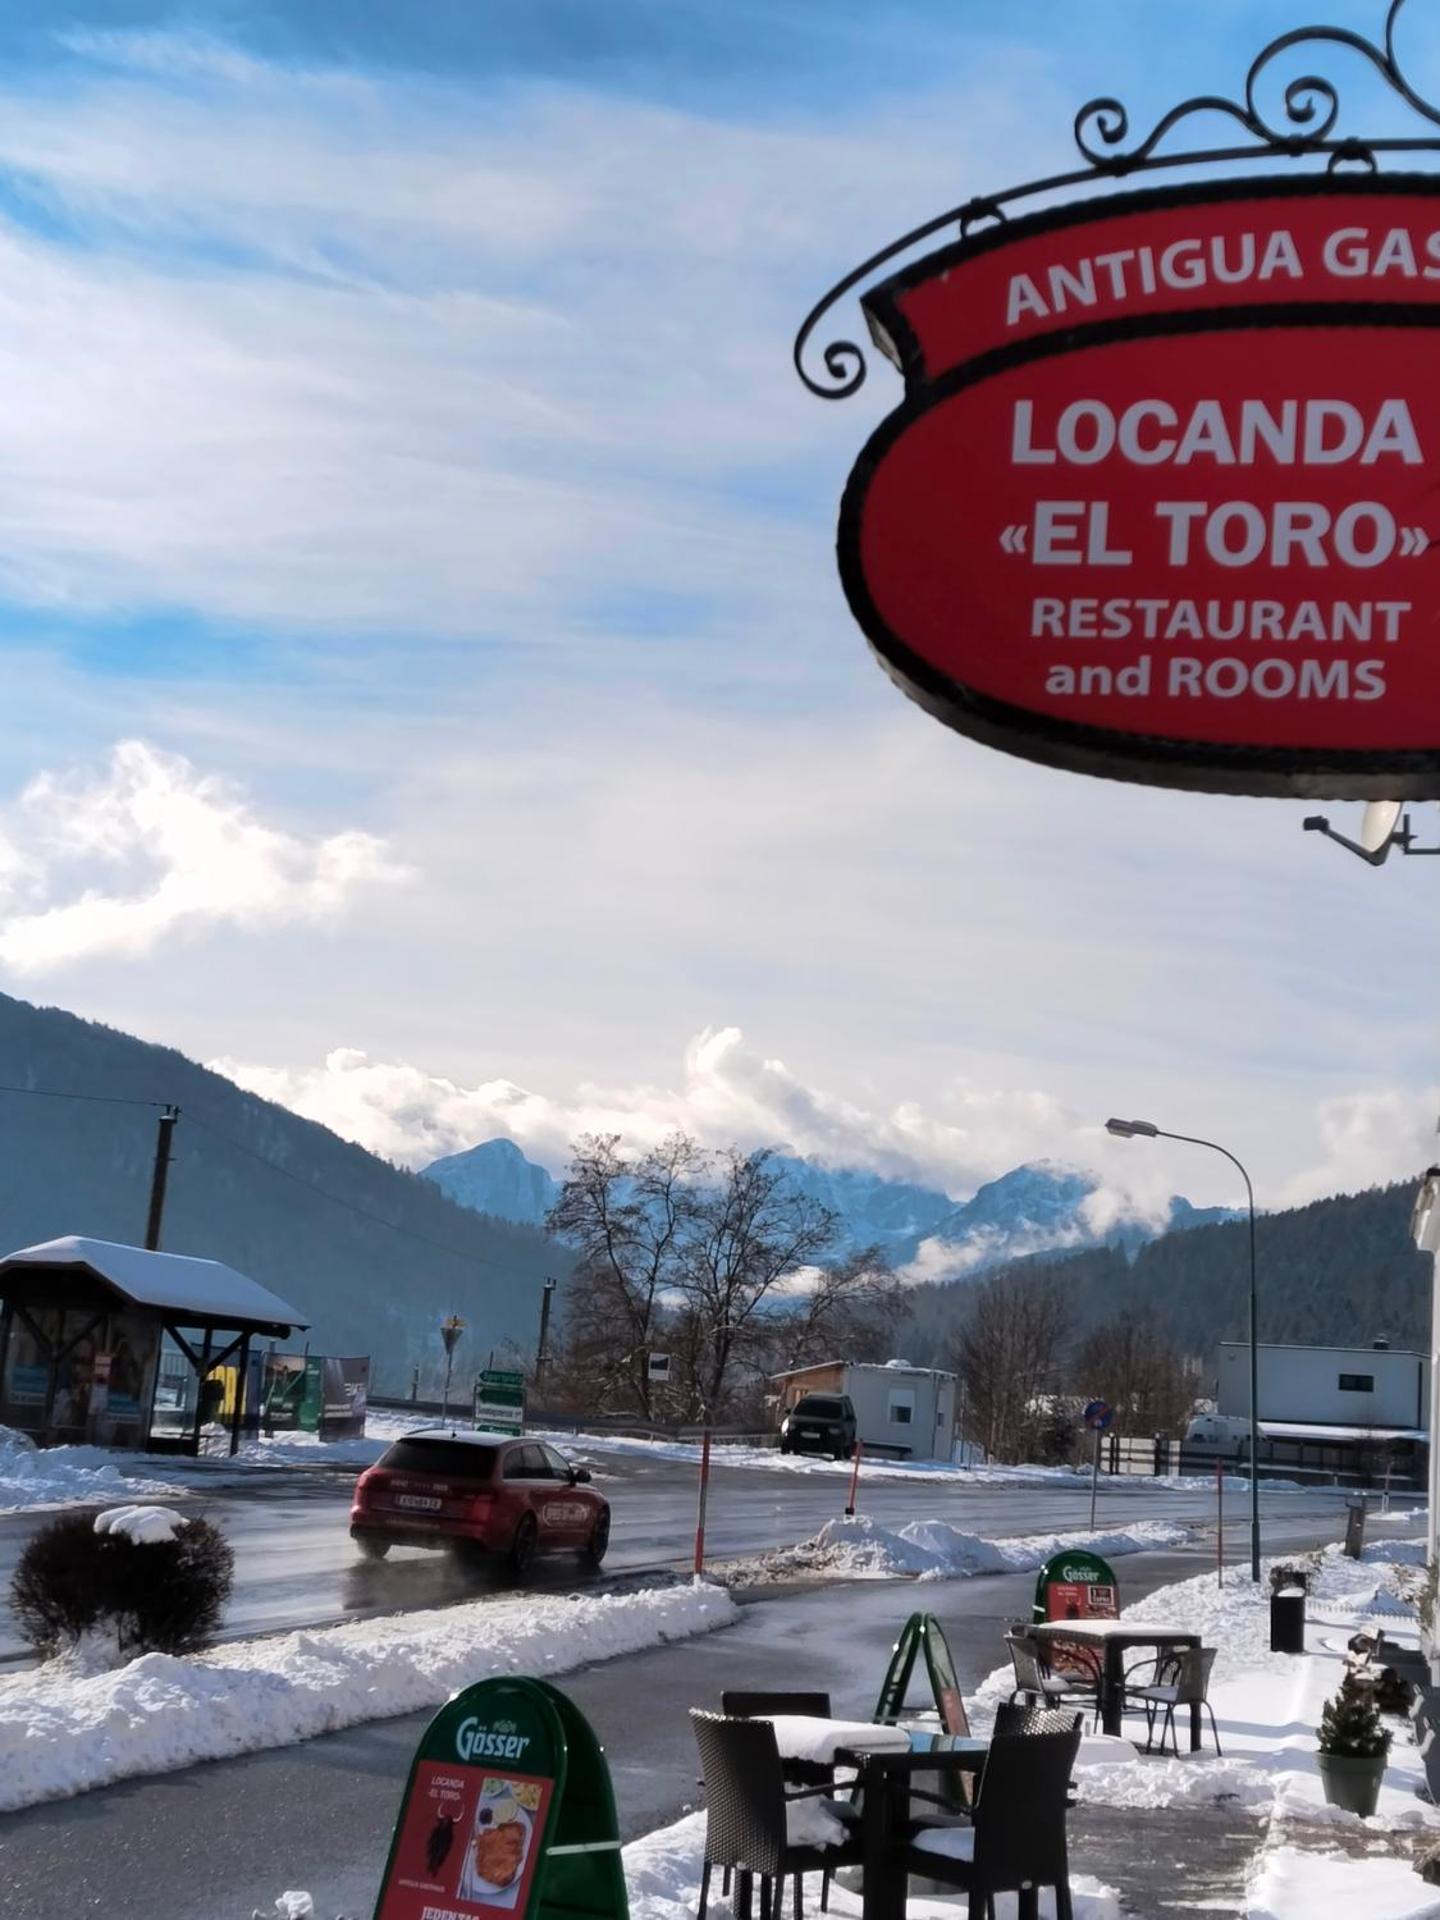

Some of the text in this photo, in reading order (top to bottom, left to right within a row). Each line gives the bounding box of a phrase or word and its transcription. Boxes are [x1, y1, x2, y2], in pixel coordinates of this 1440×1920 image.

[1007, 227, 1304, 326] ANTIGUA
[1011, 399, 1424, 466] LOCANDA
[1030, 597, 1412, 642] RESTAURANT
[1045, 655, 1387, 700] and ROOMS
[456, 1716, 531, 1761] Gösser
